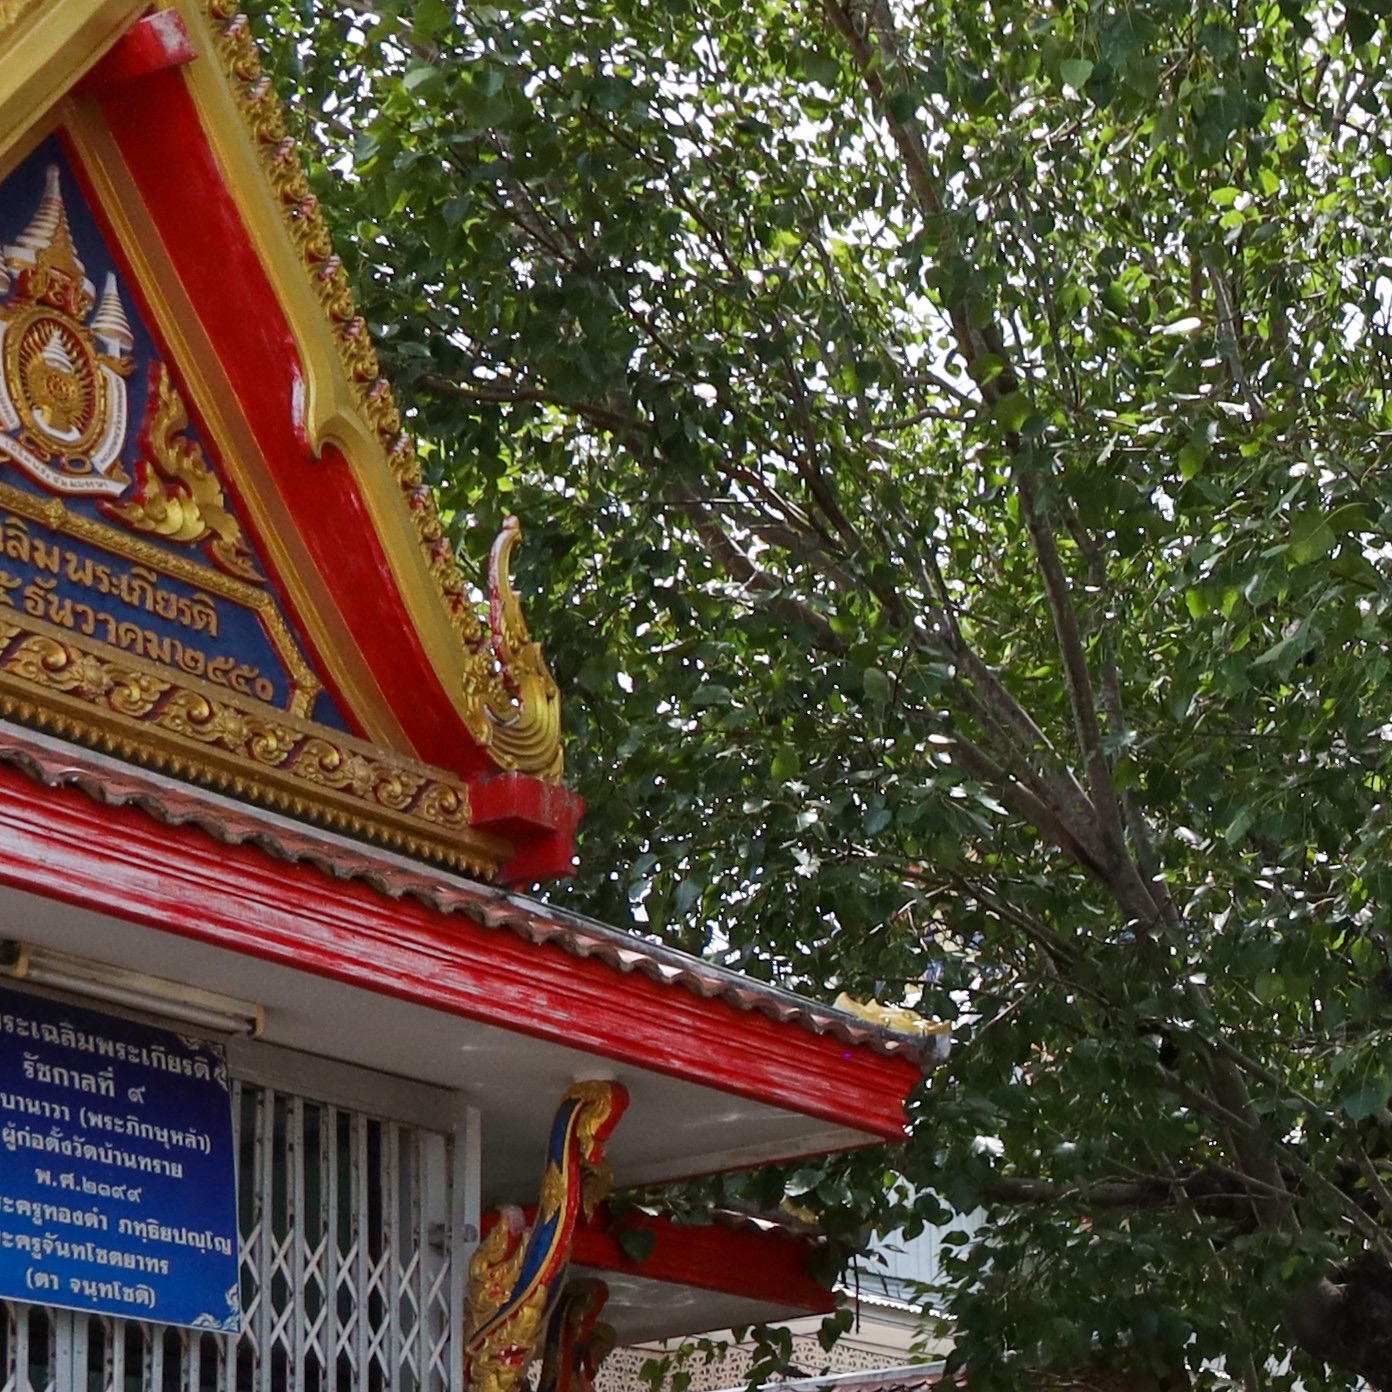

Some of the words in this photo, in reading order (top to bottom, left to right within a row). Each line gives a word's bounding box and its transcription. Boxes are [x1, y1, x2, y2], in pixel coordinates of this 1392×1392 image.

[0, 516, 219, 638] ลิมพระเกียรติ
[0, 1012, 210, 1081] ระเฉลิมพระเกียรติ
[22, 1050, 115, 1098] รัชกาลที่
[0, 1196, 108, 1231] ะครูทองดำ
[0, 1230, 170, 1276] ะครูจันทโชตยาทร
